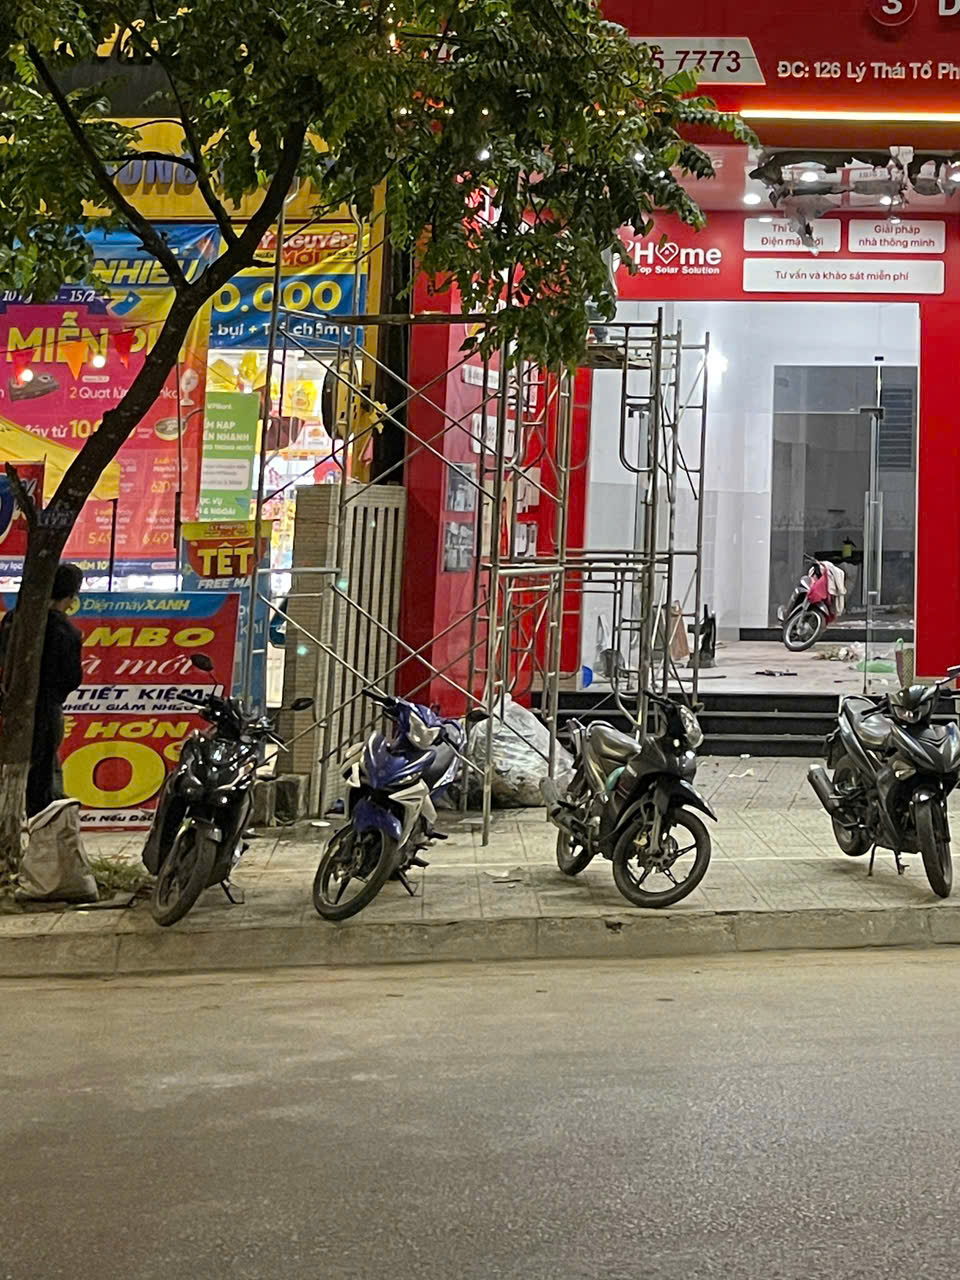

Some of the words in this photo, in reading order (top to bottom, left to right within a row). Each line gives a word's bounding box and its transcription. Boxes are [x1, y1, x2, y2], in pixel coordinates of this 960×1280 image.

[675, 50, 741, 73] 7773
[777, 61, 810, 78] ĐC:
[814, 61, 841, 78] 126
[847, 62, 867, 83] Lý
[870, 62, 906, 79] Thái
[894, 224, 921, 237] pháp
[858, 238, 878, 247] nhà
[879, 236, 909, 250] thông
[910, 238, 935, 248] minh
[655, 265, 678, 274] Solar
[681, 266, 720, 275] Solution
[775, 271, 791, 280] Tư
[793, 268, 807, 280] vấn
[810, 270, 821, 280] và
[849, 270, 864, 281] sát
[866, 269, 891, 281] miễn
[893, 270, 909, 283] phí
[70, 290, 95, 303] 15/2
[197, 541, 255, 575] TẾT
[198, 577, 235, 590] FREE
[77, 685, 128, 700] TIẾT
[84, 718, 190, 739] HƠN
